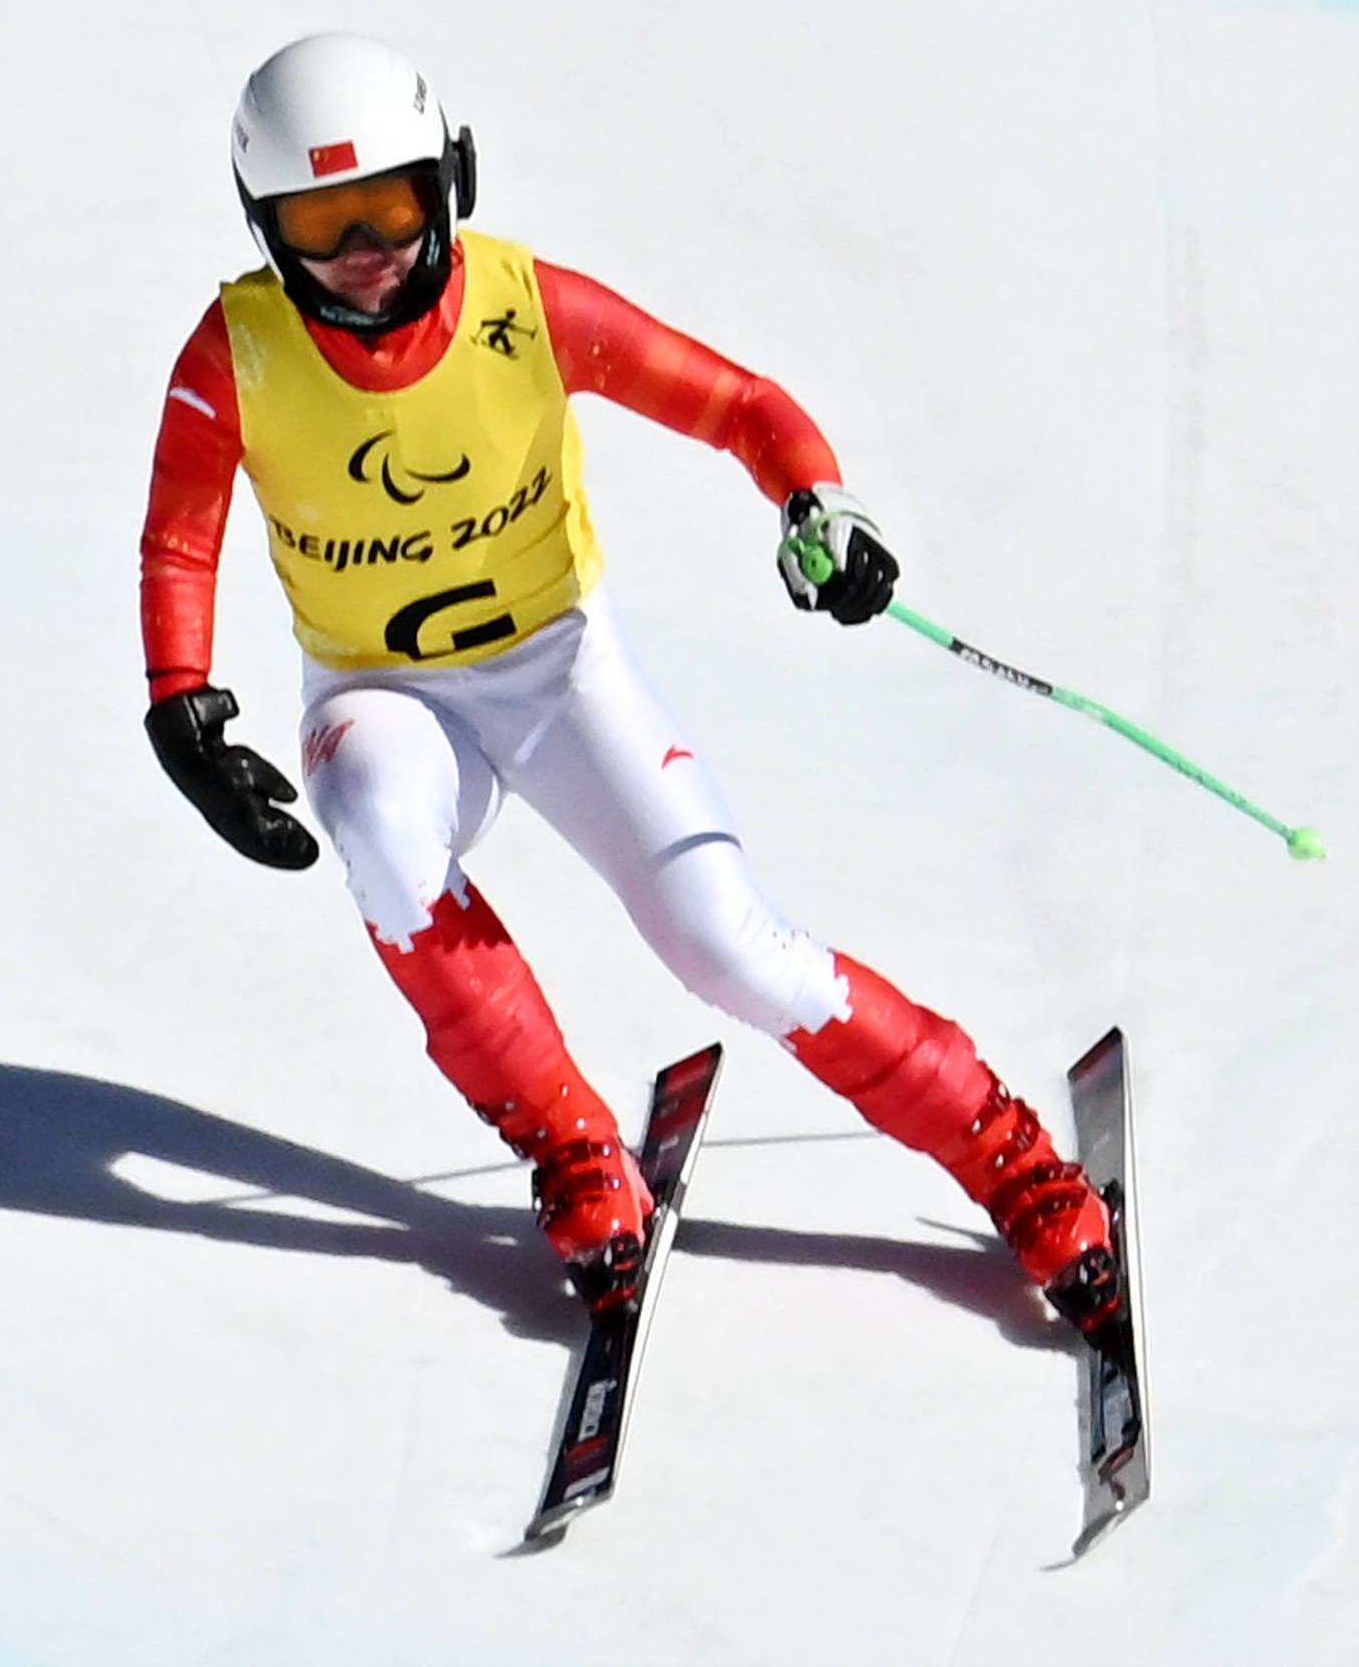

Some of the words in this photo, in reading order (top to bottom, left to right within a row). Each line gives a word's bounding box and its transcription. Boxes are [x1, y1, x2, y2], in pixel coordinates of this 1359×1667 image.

[273, 519, 433, 572] BEIJING
[450, 466, 553, 550] 2022
[384, 578, 517, 662] G
